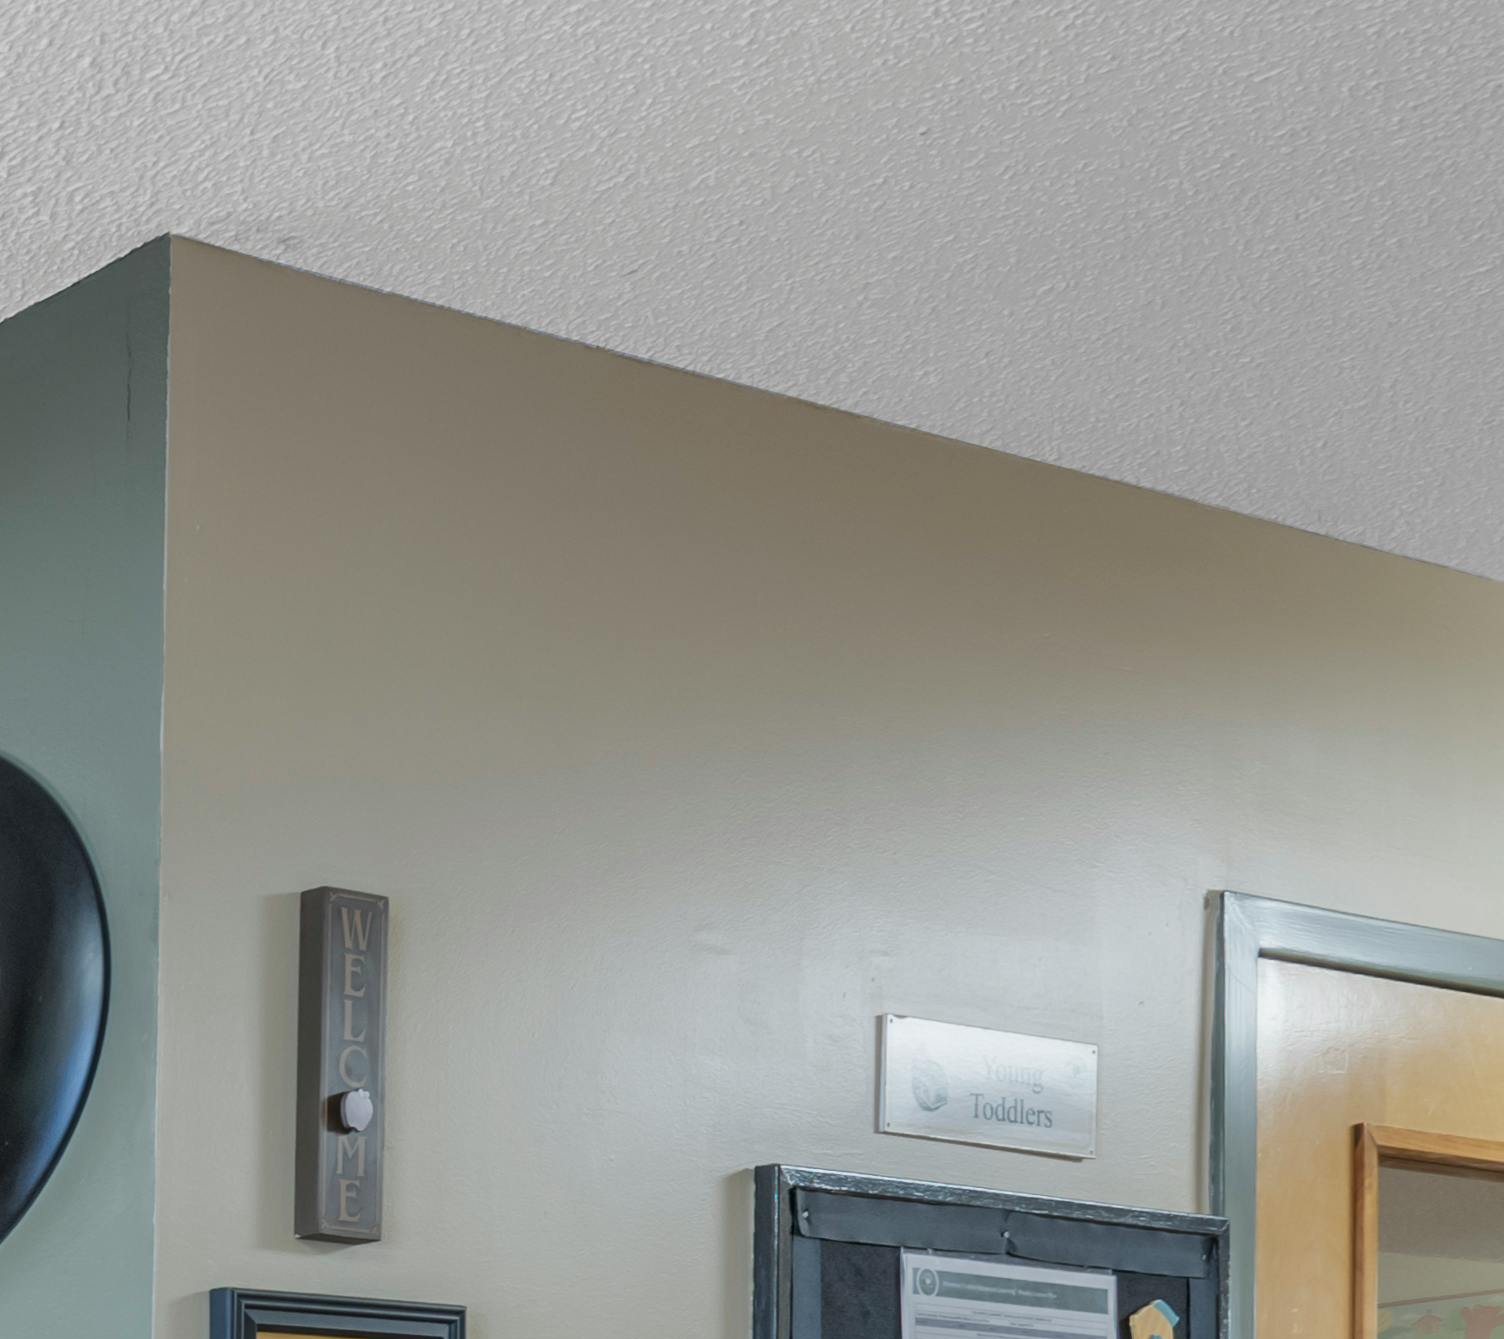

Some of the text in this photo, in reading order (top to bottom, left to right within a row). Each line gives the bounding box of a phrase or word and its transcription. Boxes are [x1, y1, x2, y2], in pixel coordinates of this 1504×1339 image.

[335, 906, 373, 1223] WELCME
[984, 1055, 1044, 1094] Young
[970, 1092, 1053, 1129] Toddlers
